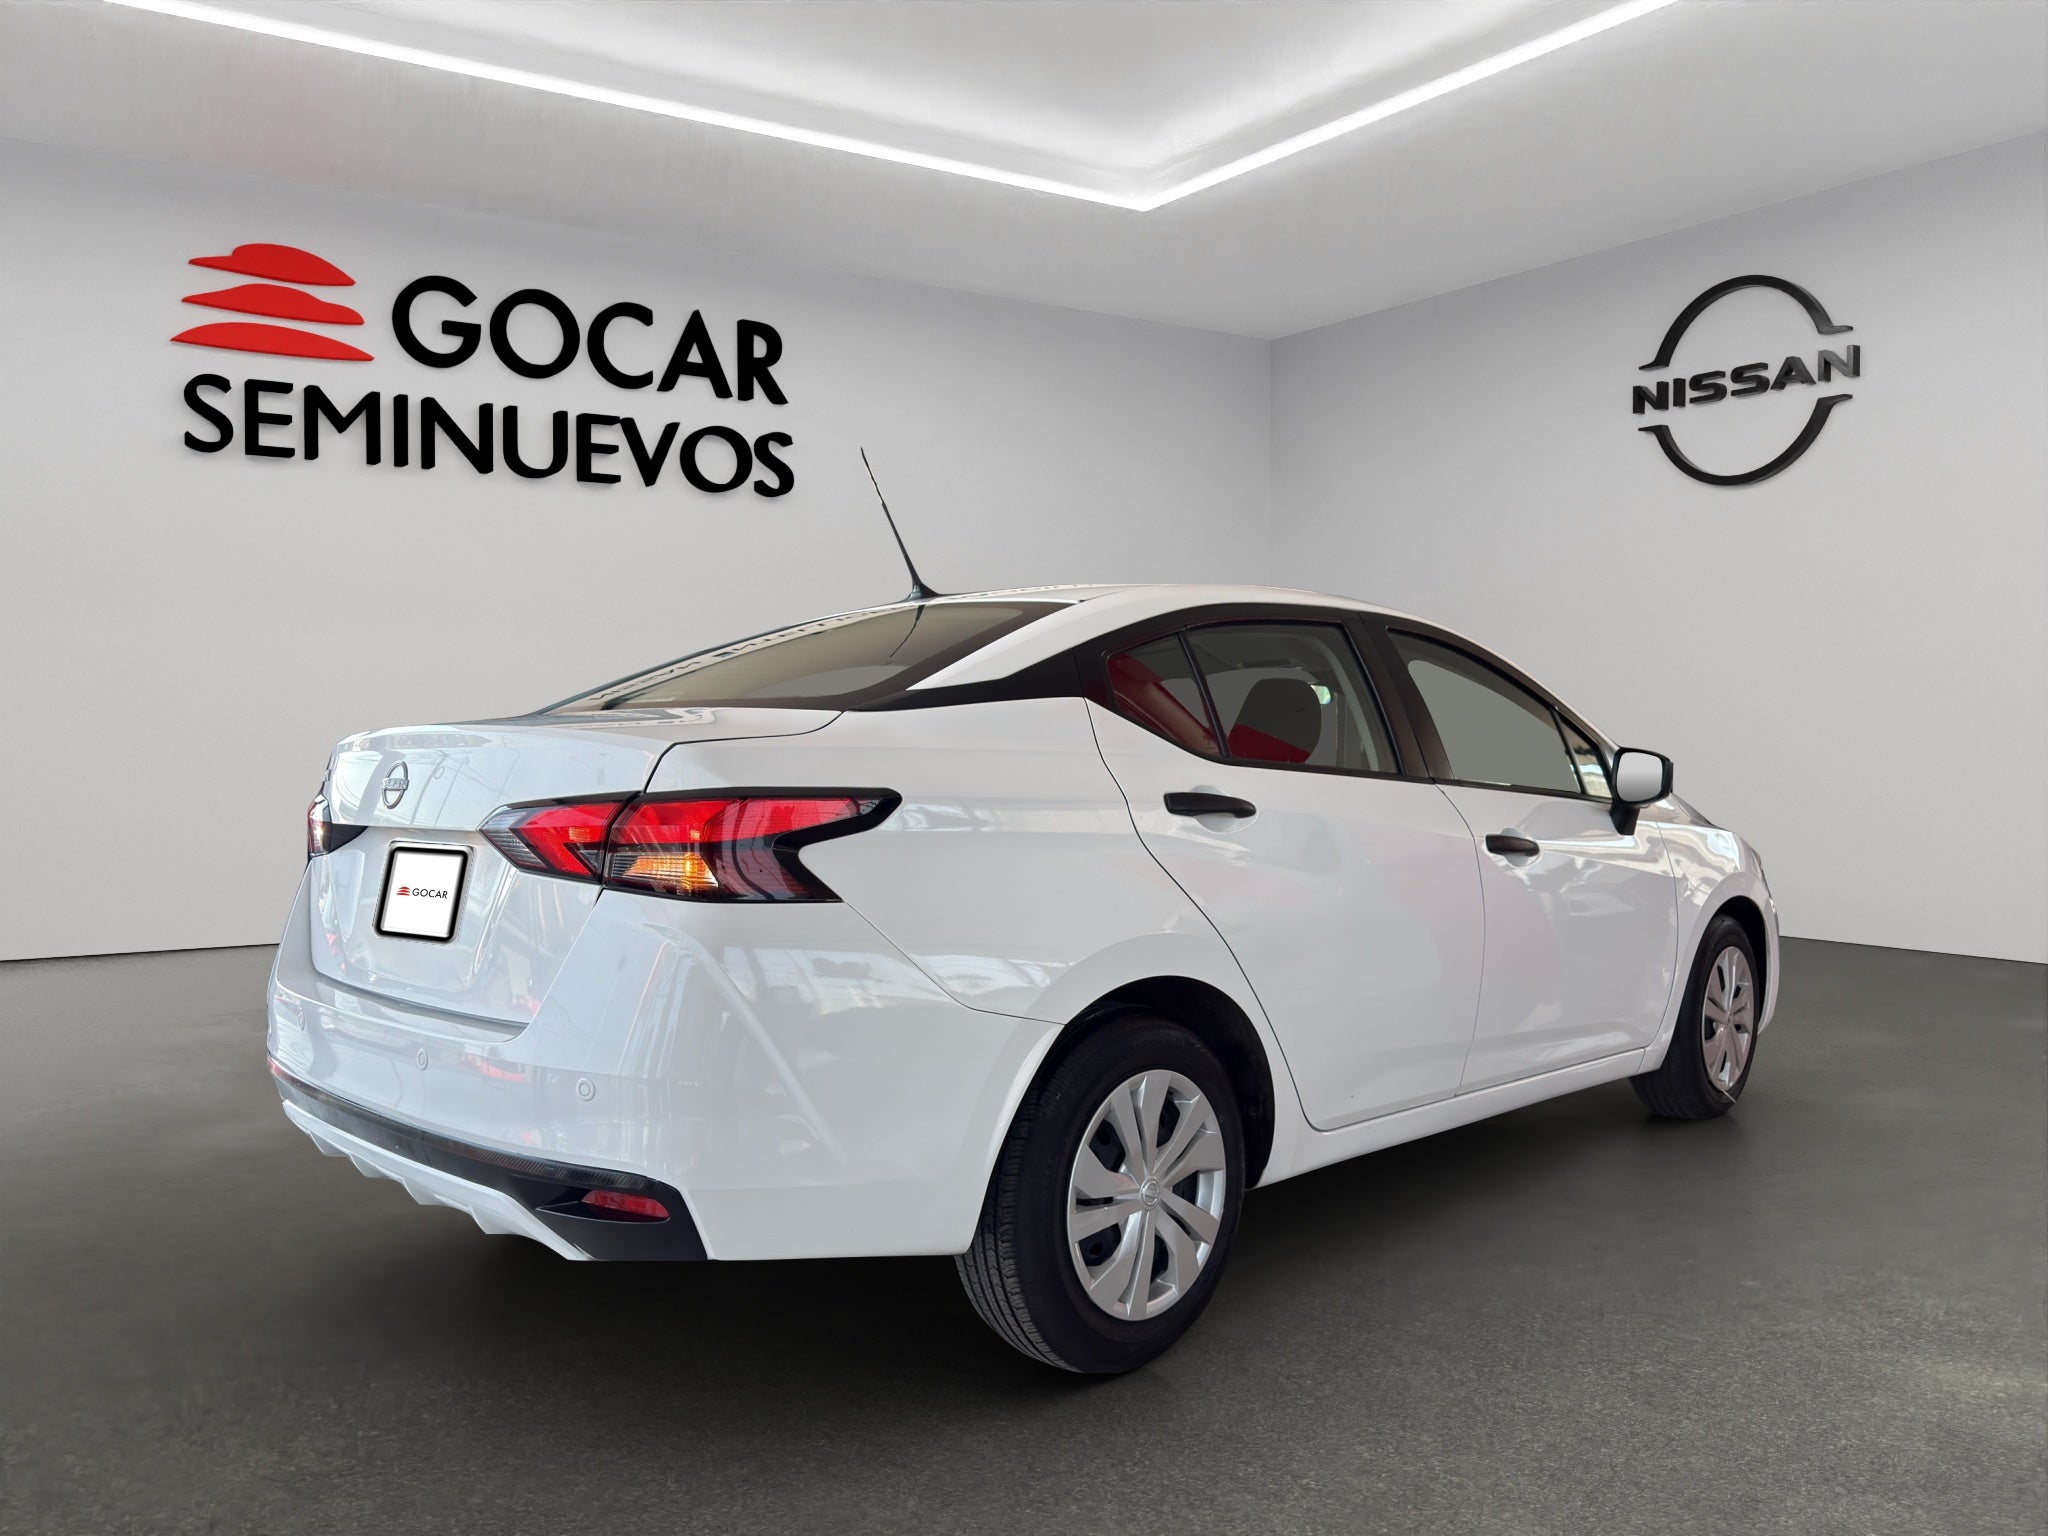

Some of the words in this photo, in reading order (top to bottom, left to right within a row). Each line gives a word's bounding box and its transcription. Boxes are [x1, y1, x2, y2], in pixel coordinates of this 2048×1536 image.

[391, 275, 789, 406] GOCAR
[1632, 344, 1861, 415] NISSAN
[183, 373, 795, 498] SEMINUEVOS
[412, 887, 448, 899] GOCAR
